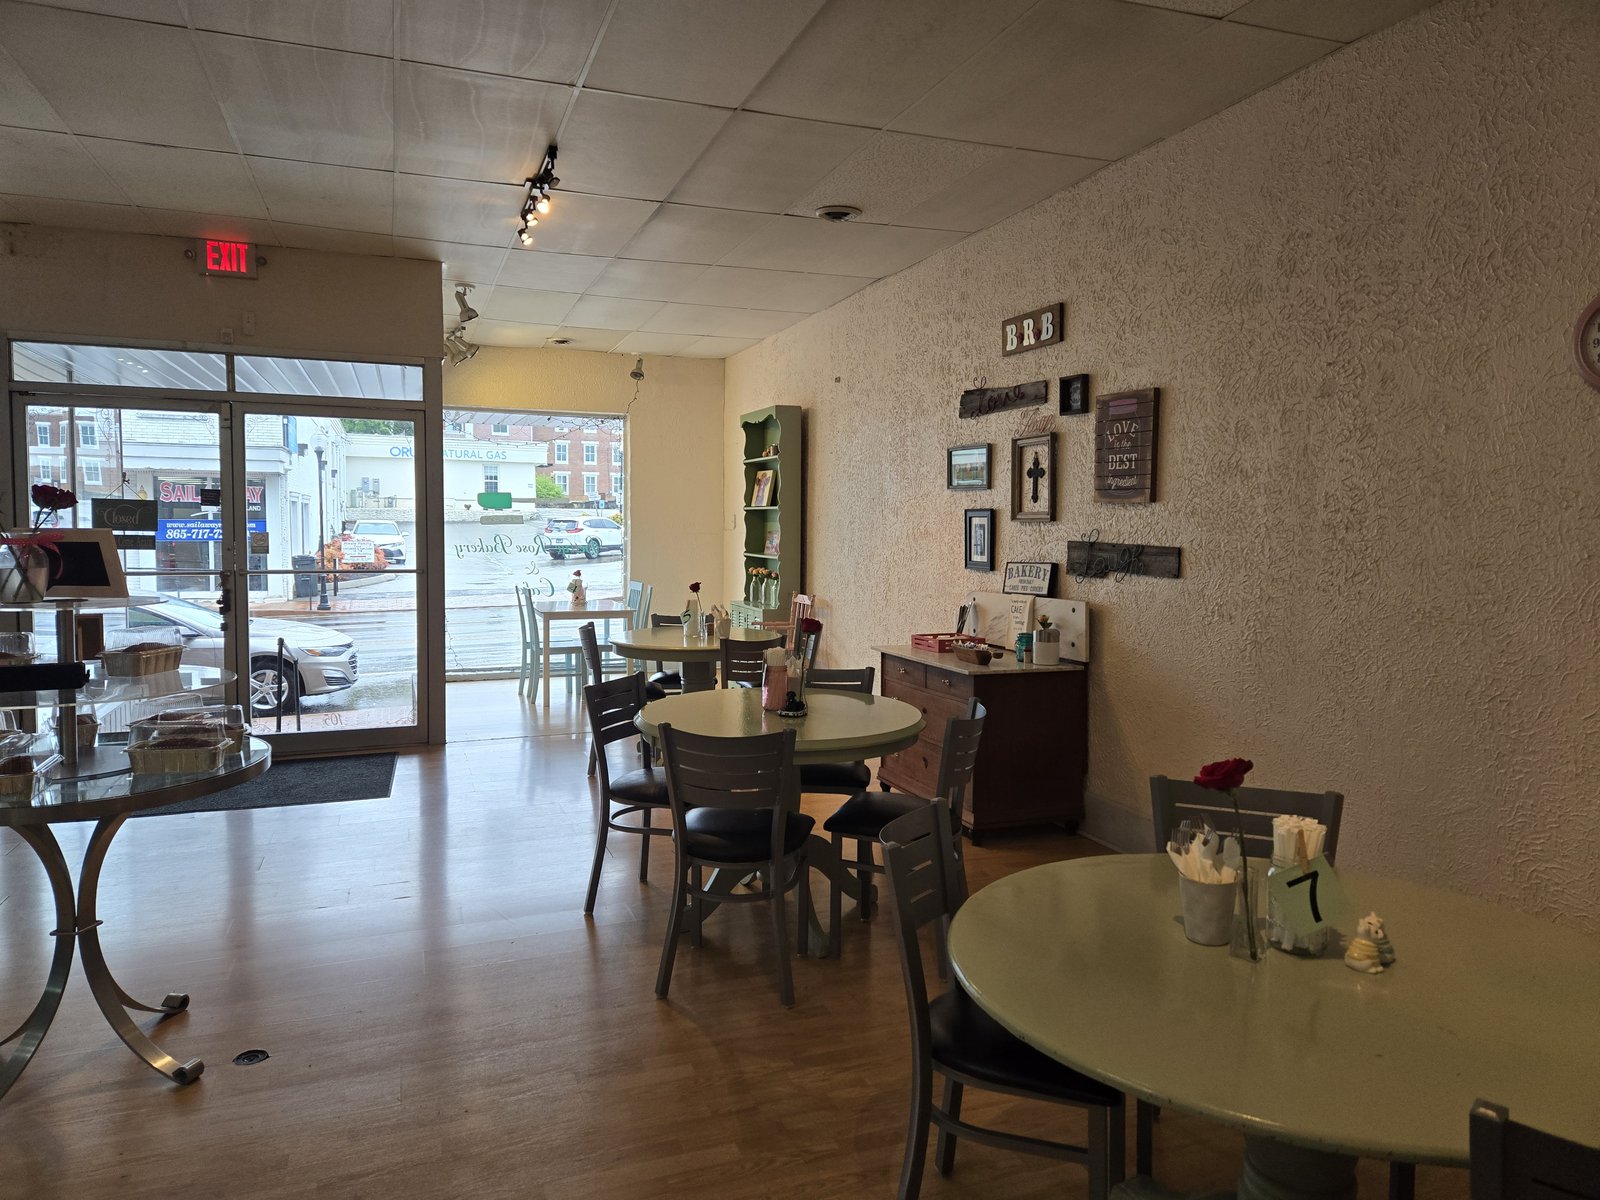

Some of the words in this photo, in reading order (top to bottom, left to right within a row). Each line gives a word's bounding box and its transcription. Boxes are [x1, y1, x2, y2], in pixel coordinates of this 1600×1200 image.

[207, 240, 248, 273] EXIT
[1106, 420, 1139, 442] LOVE
[1121, 438, 1132, 450] the
[443, 449, 483, 460] ATURAL
[486, 450, 507, 460] GAS
[1108, 453, 1138, 470] BEST
[160, 481, 201, 503] SAIL
[246, 486, 264, 503] AY
[1107, 475, 1137, 489] ingredient
[101, 504, 145, 528] Closed
[1008, 564, 1049, 582] BAKERY
[1286, 869, 1323, 924] 7
